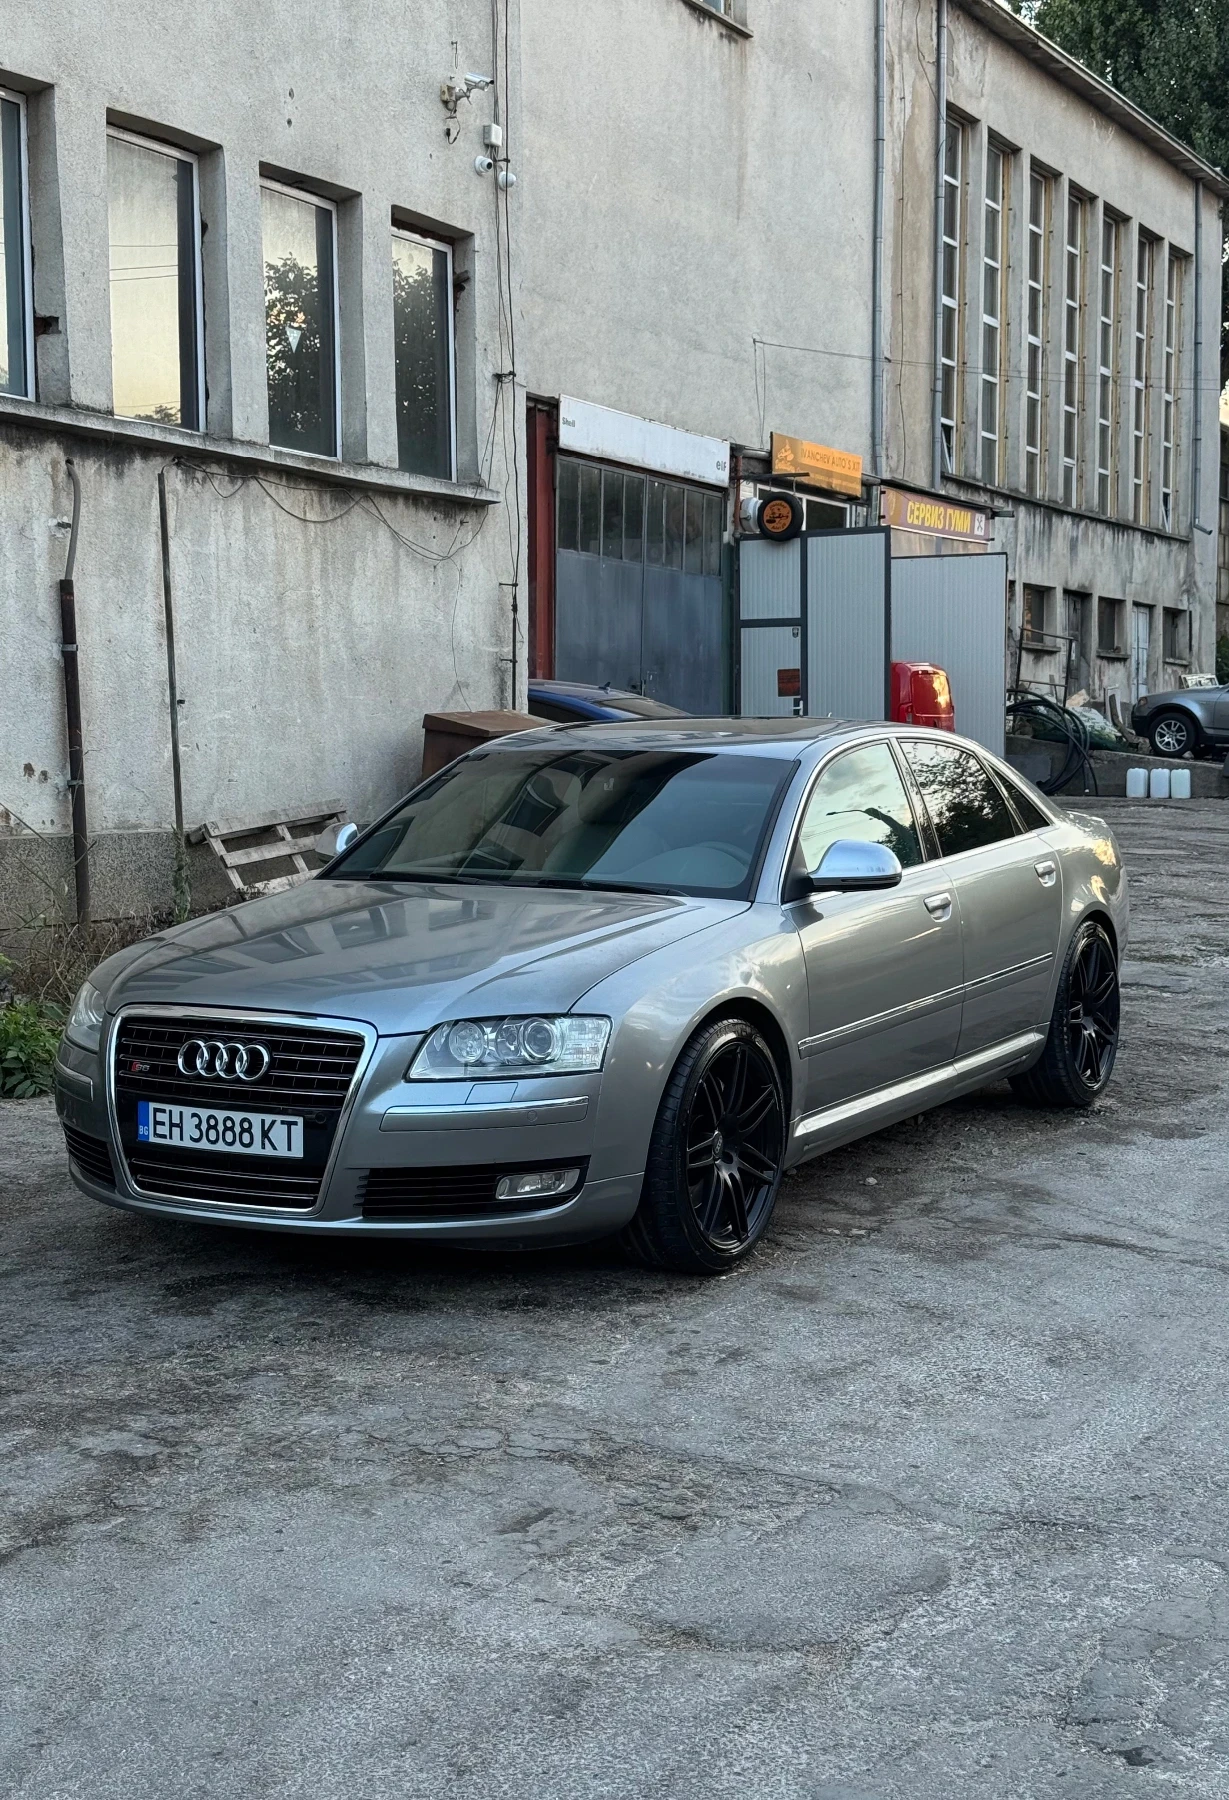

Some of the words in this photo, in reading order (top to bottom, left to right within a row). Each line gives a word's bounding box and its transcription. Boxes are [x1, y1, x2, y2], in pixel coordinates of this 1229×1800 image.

[907, 501, 944, 530] СЕРВИЗ
[945, 508, 972, 534] ГУМИ
[138, 1125, 149, 1136] BG
